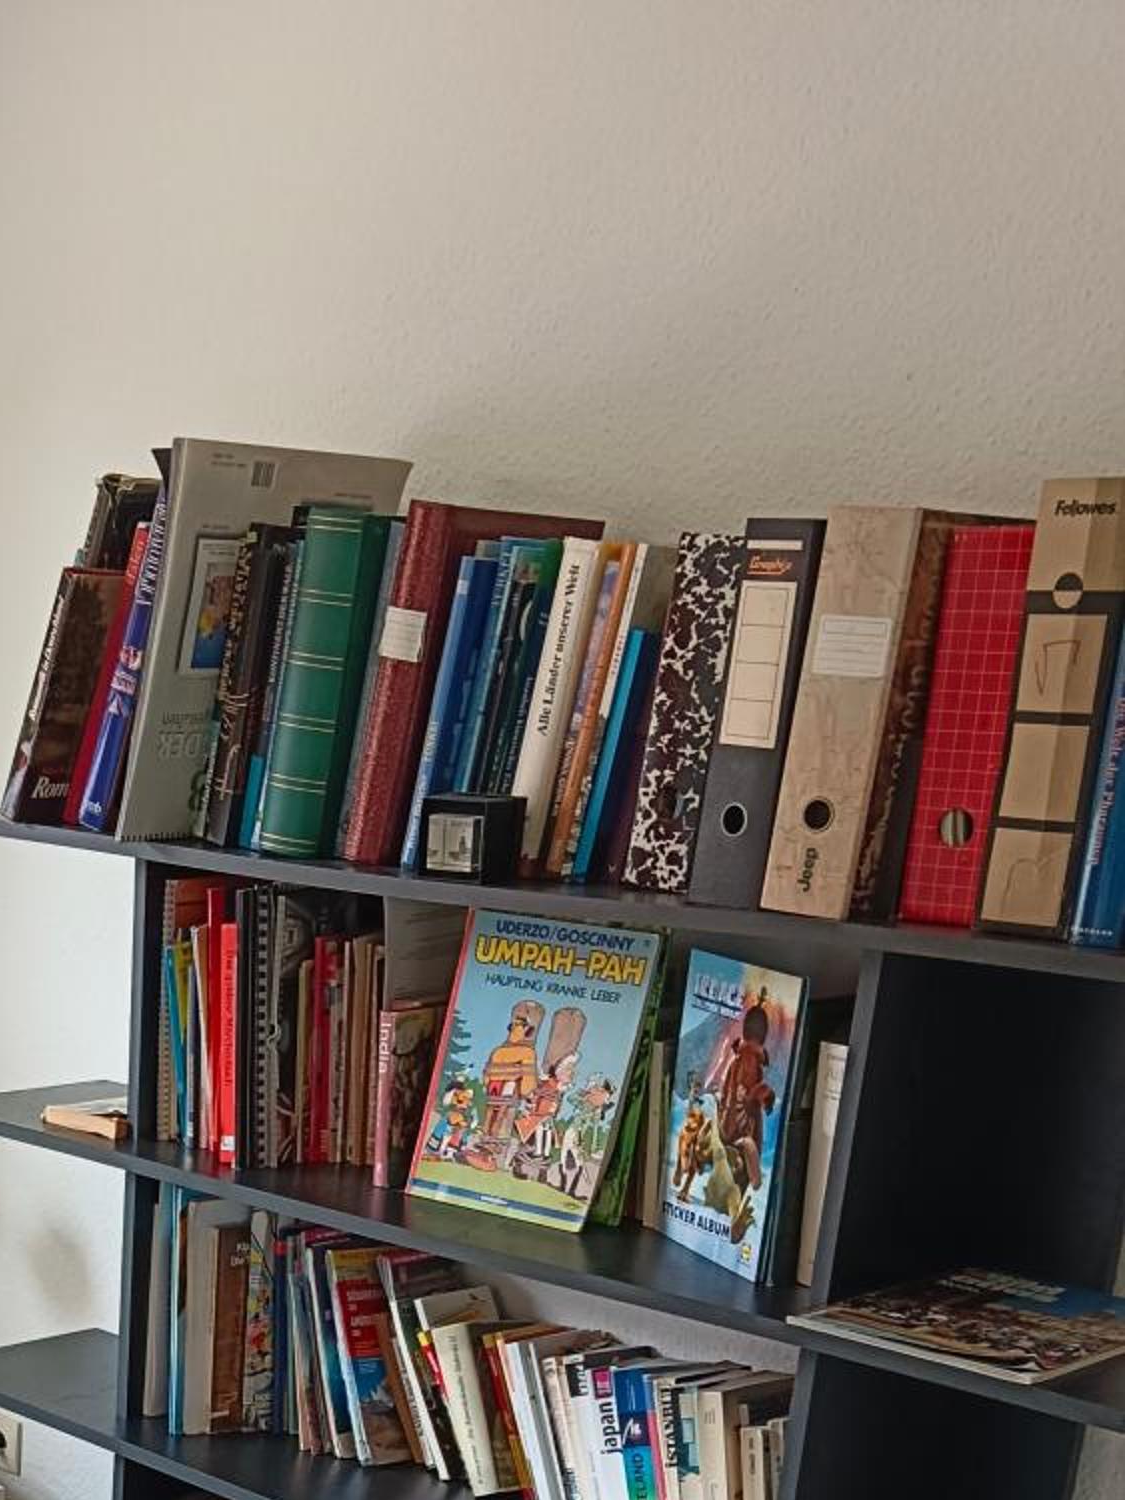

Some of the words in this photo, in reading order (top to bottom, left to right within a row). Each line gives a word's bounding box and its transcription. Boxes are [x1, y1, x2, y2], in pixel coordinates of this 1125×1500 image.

[1054, 499, 1117, 516] Fellowes
[565, 564, 580, 598] Welt
[556, 600, 574, 653] unserer
[543, 656, 562, 703] Länder
[537, 706, 553, 736] Alle
[797, 847, 819, 893] Jeep
[495, 919, 636, 950] UDERZO/GOSCINNY
[476, 935, 646, 986] UMPAH-PAH
[380, 1022, 390, 1074] India
[697, 1215, 731, 1238] ALBUM
[601, 1402, 618, 1455] japan
